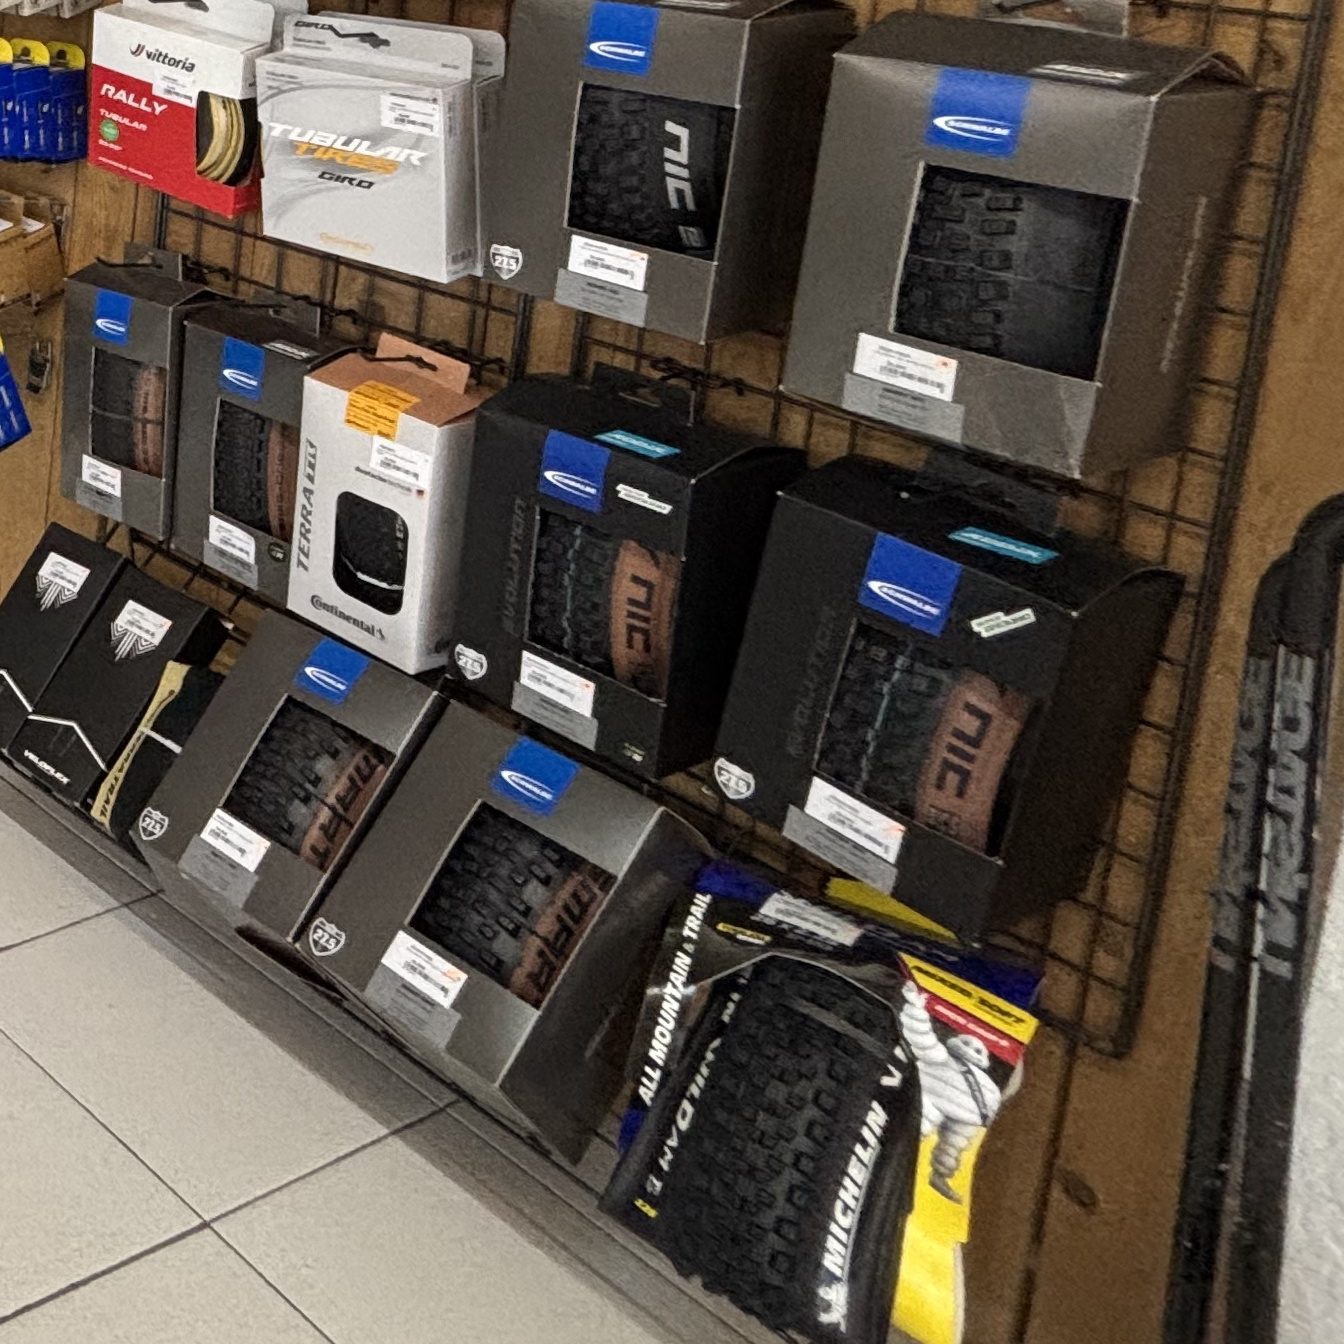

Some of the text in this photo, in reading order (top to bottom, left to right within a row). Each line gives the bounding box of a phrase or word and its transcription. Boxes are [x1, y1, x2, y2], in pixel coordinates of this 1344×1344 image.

[145, 47, 196, 74] vittoria
[99, 82, 169, 116] RALLY
[267, 122, 429, 168] TUBULAR
[292, 140, 402, 176] TIRES
[663, 119, 694, 212] NIC
[317, 171, 376, 191] GIRO
[296, 482, 319, 573] TERRA
[311, 594, 376, 637] Continental
[626, 575, 658, 659] NIC
[23, 749, 71, 786] VELOFLEX
[935, 701, 993, 800] NIC
[682, 891, 713, 942] TRAIL
[648, 949, 693, 1063] MOUNTAIN
[637, 1060, 665, 1108] ALL
[820, 1100, 889, 1282] MICHELIN
